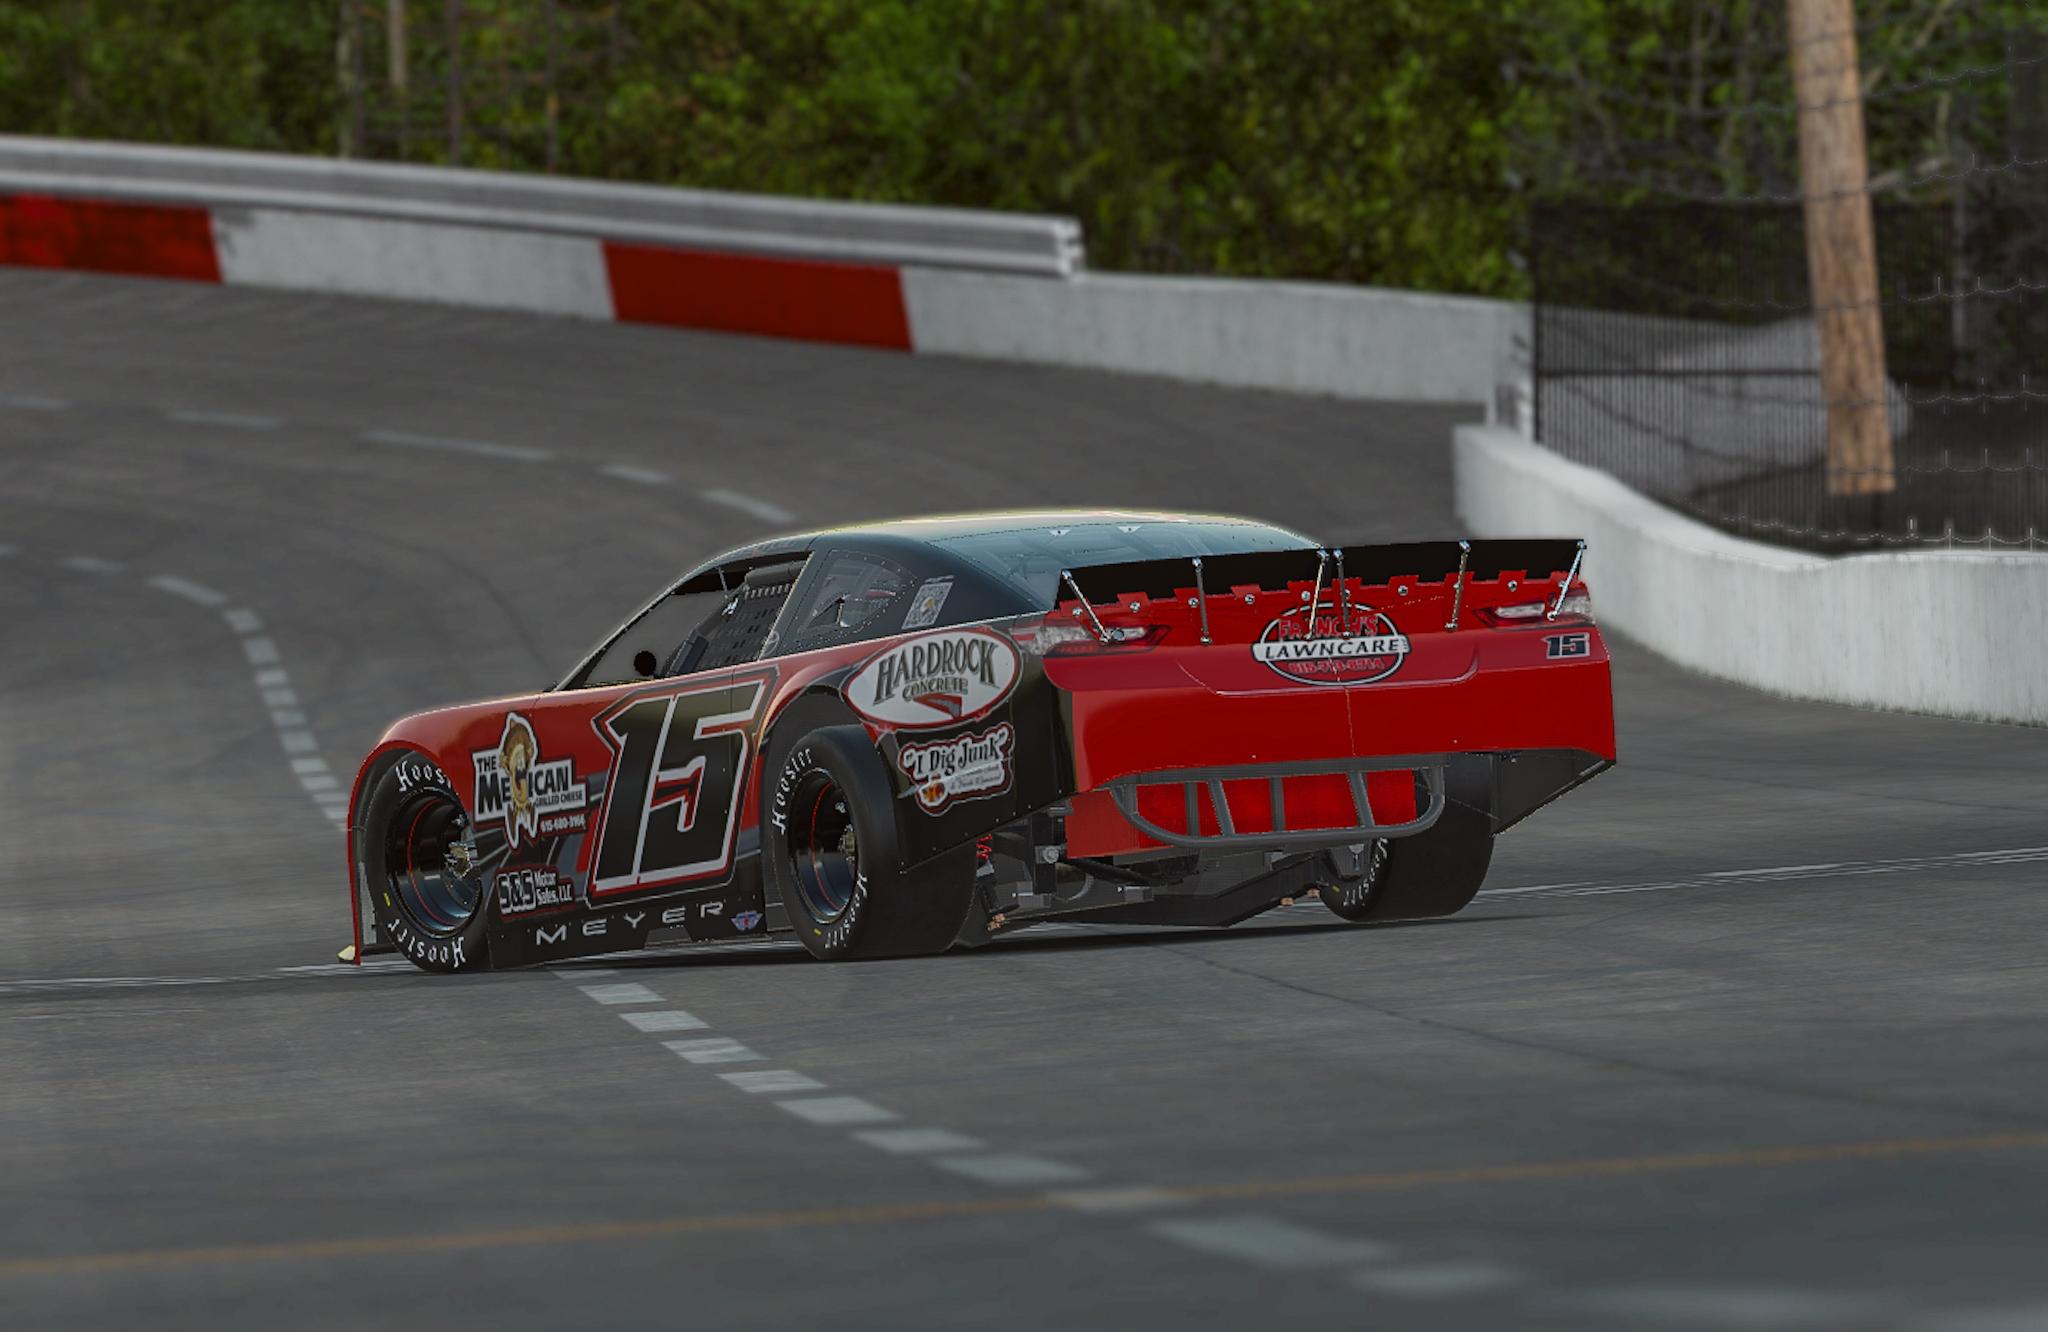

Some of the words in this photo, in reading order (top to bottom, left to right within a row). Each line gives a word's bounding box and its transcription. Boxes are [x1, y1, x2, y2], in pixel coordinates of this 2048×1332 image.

[1266, 639, 1399, 660] LAWNCARE
[1542, 632, 1590, 659] 15
[873, 638, 1000, 706] HARDROCK
[902, 676, 968, 702] CONCRETE
[477, 755, 497, 772] THE
[930, 748, 955, 776] Dig
[594, 678, 766, 891] 15
[535, 793, 560, 807] GRILLED
[560, 790, 583, 804] CHEESE
[534, 870, 556, 887] Motor
[559, 883, 573, 902] LLC
[536, 900, 724, 945] MEYER
